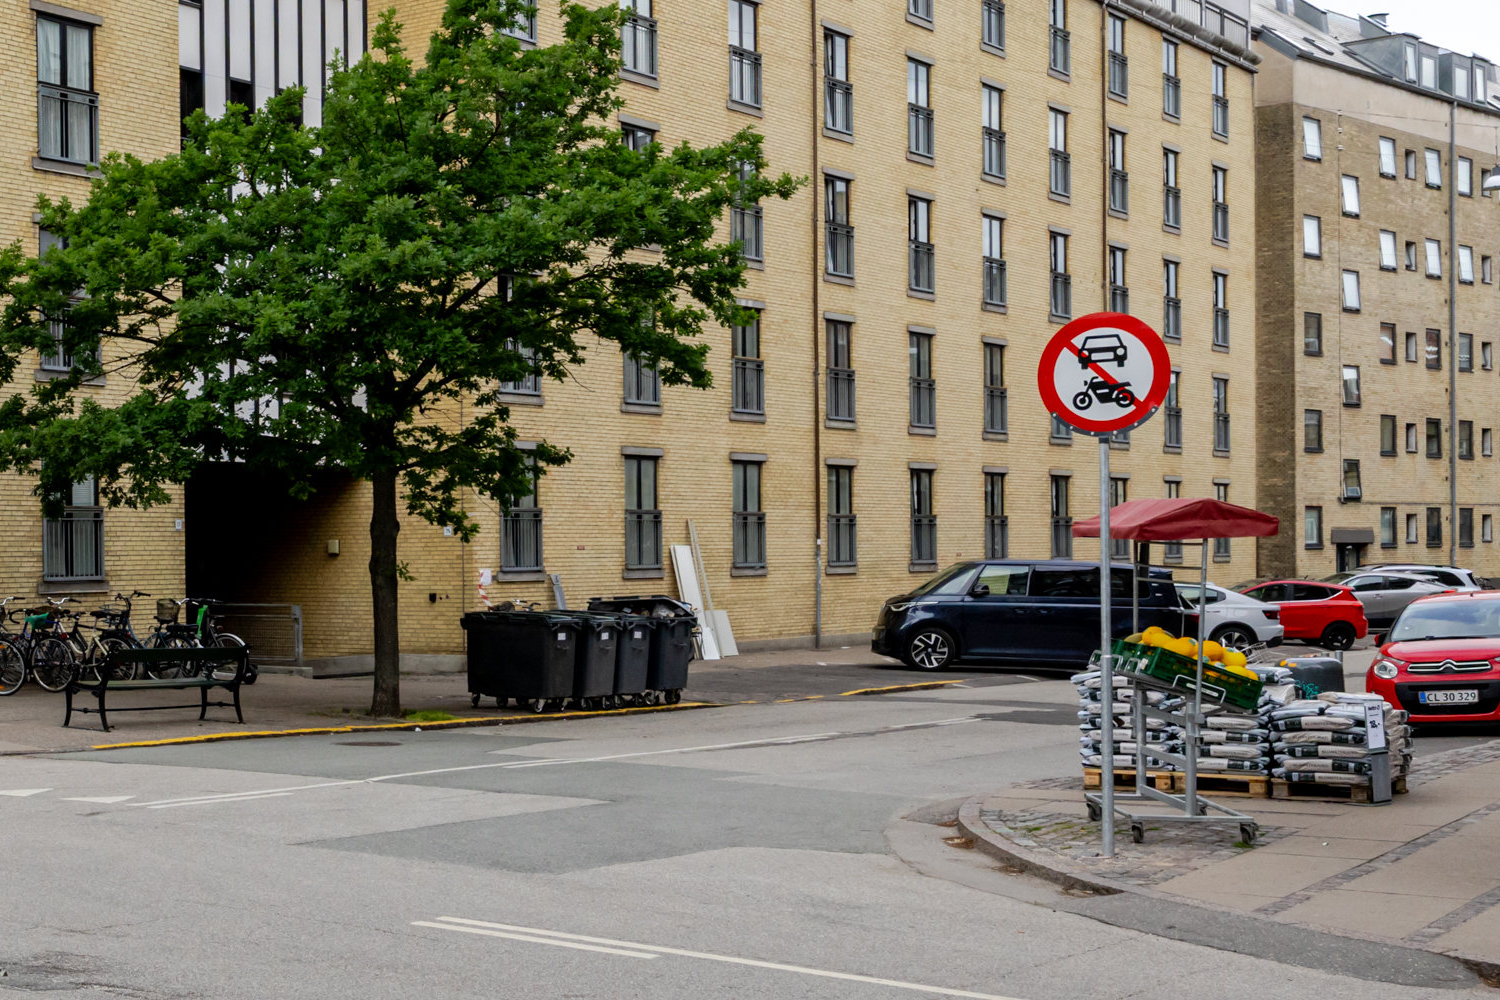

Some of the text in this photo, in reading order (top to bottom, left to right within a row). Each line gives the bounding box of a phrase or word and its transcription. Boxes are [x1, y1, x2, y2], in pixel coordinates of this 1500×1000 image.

[1426, 691, 1477, 702] CL 30 329
